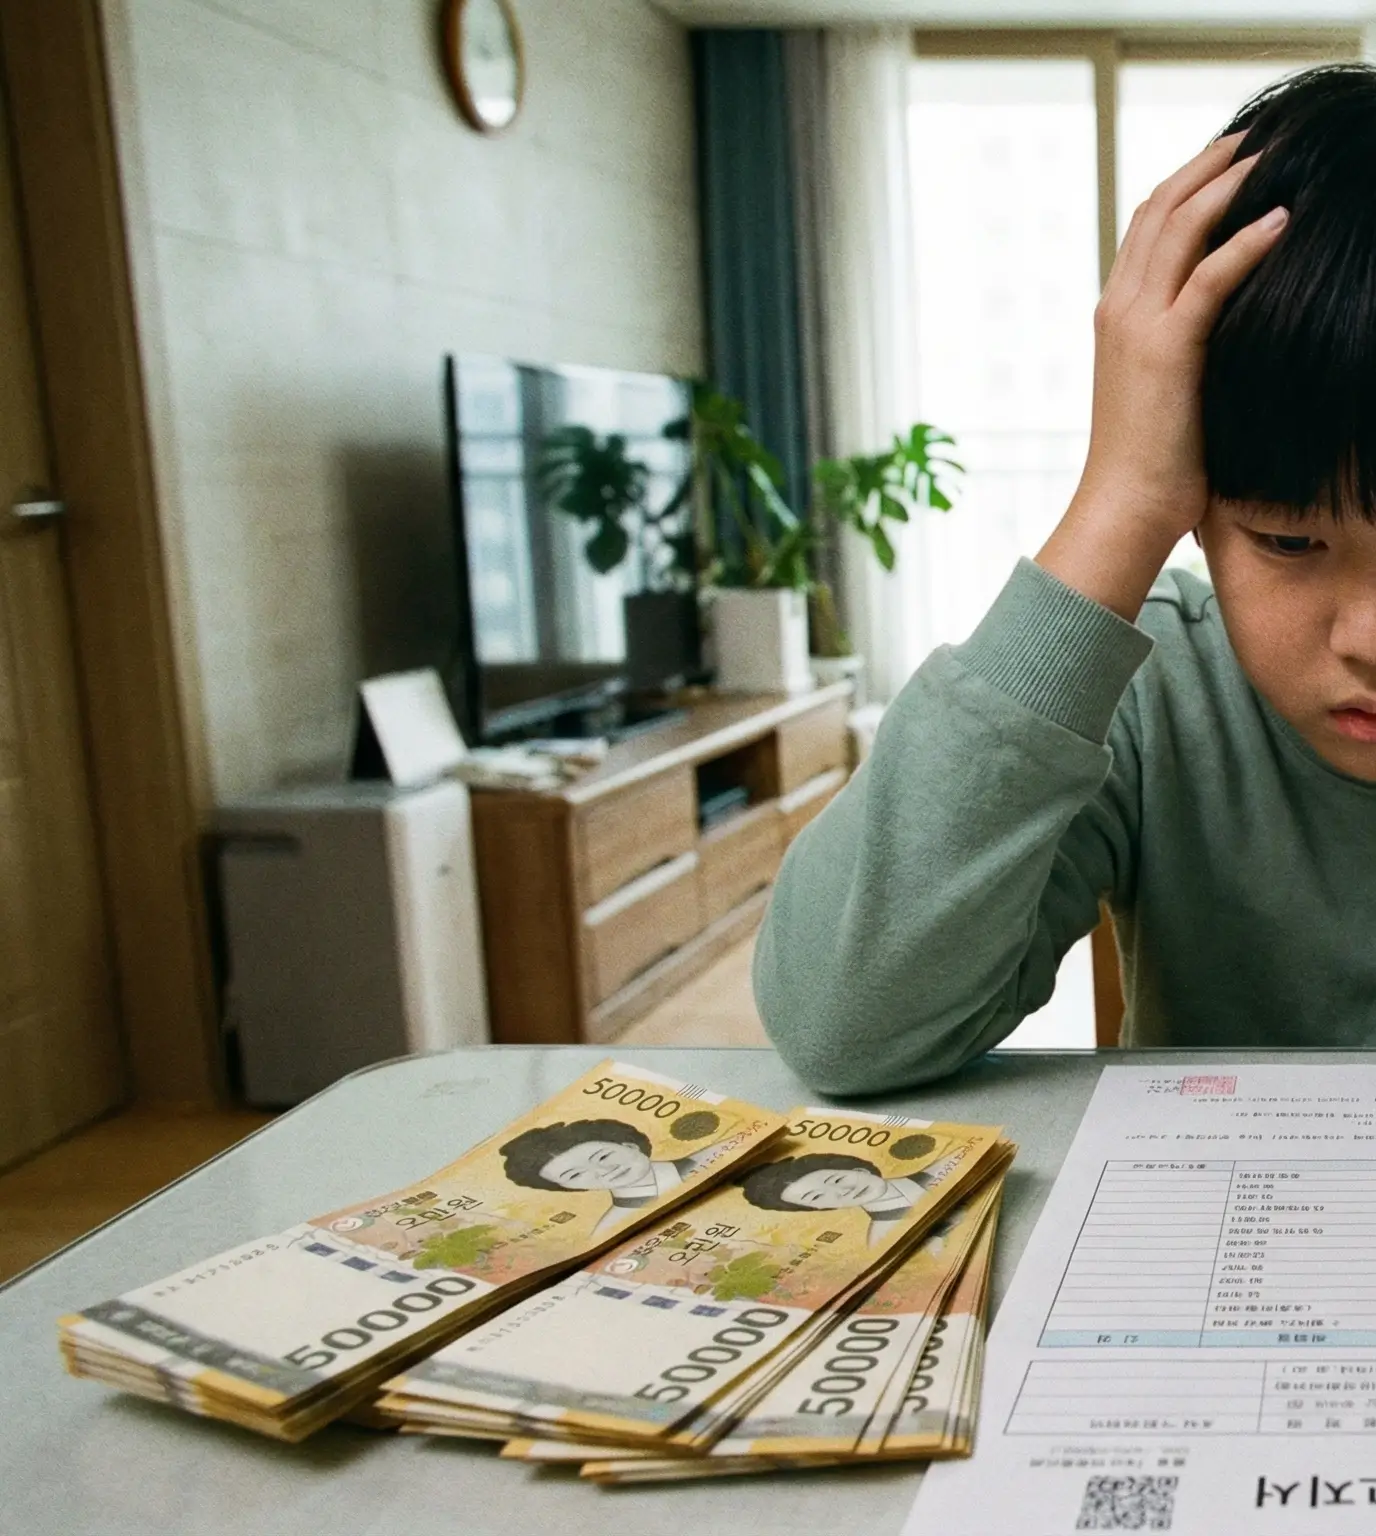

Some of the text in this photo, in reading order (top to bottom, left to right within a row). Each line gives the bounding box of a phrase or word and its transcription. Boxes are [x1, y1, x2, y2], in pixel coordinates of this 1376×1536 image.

[582, 1077, 680, 1119] 50000
[789, 1119, 890, 1147] 50000
[447, 1195, 484, 1210] 원
[284, 1276, 476, 1370] 50000
[634, 1308, 789, 1404] 50000
[797, 1318, 900, 1417] 50000
